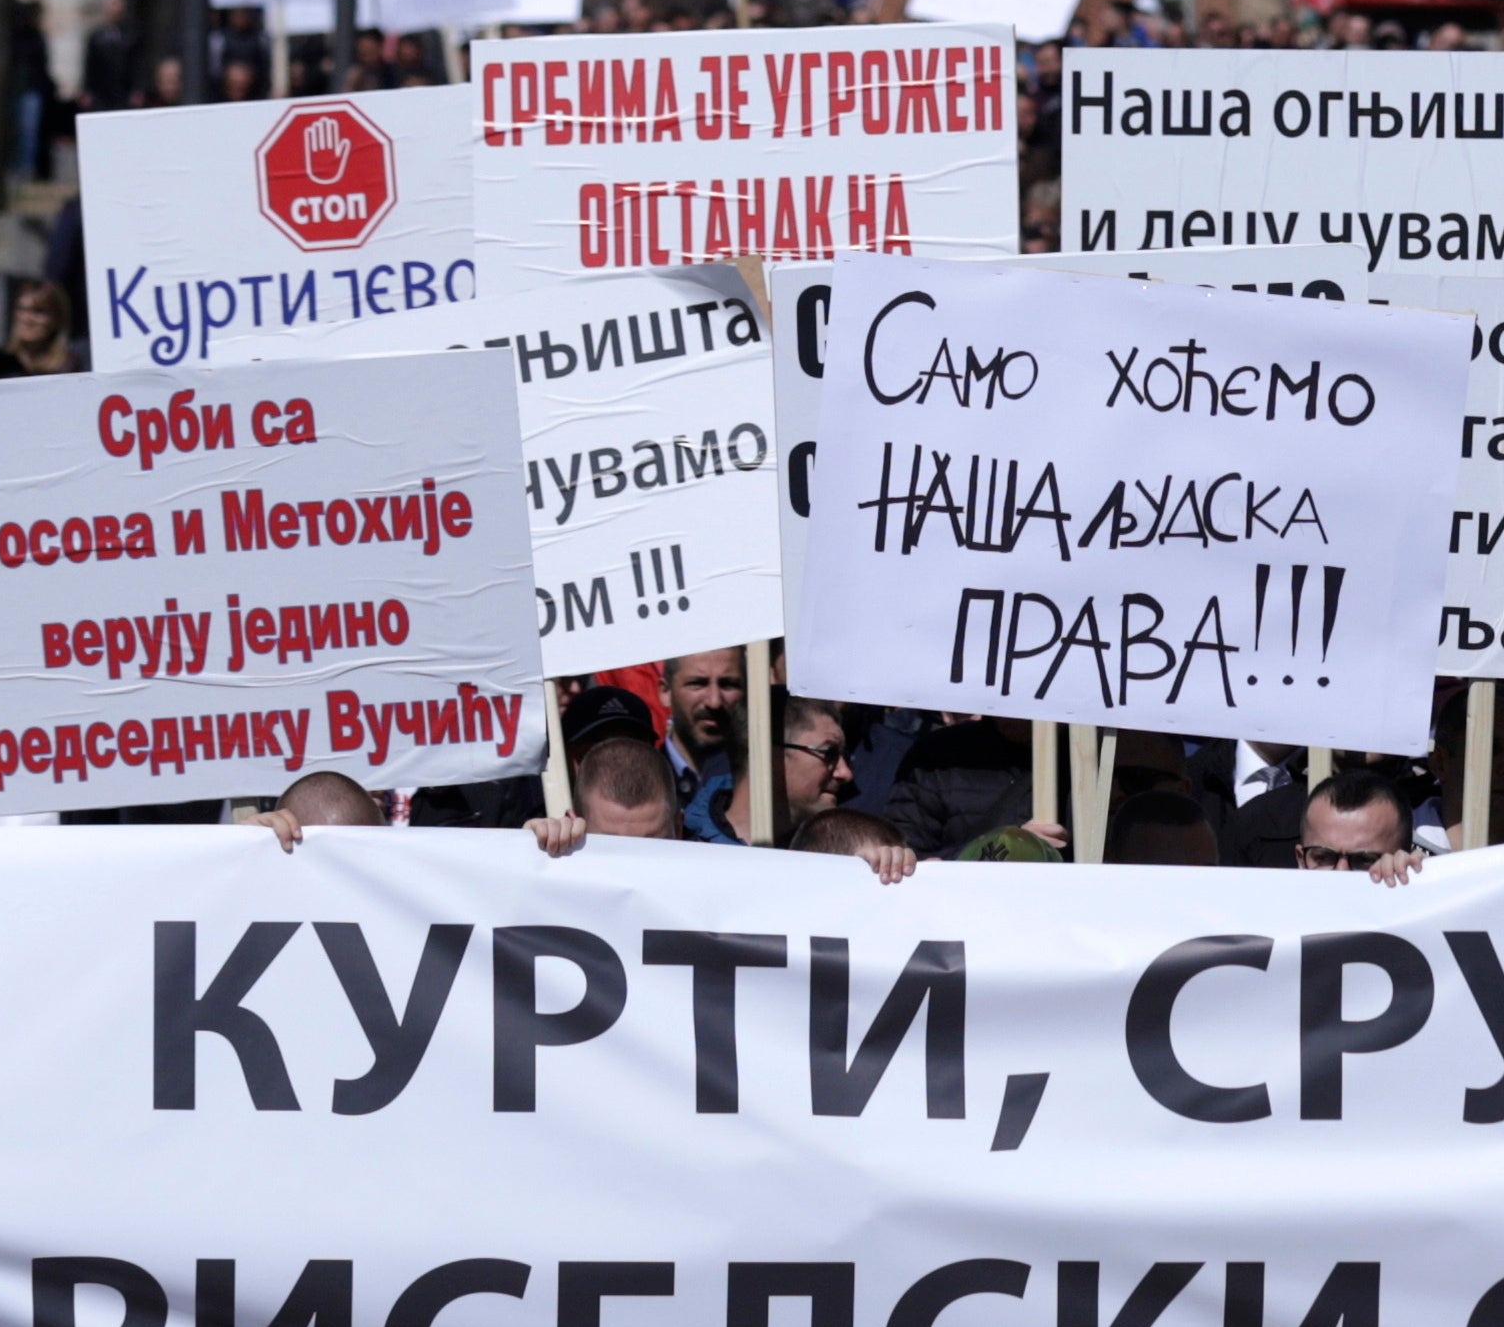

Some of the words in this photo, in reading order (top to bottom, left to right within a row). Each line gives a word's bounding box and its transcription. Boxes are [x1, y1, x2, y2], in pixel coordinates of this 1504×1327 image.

[485, 59, 681, 146] СРБИМА
[697, 56, 750, 140] ЈЕ
[766, 47, 1002, 137] УГРОЖЕН
[1072, 71, 1250, 137] Наша
[581, 177, 833, 267] ОПСТАНАК
[850, 175, 911, 255] НА
[100, 391, 233, 469] Срби
[254, 400, 314, 445] са
[173, 510, 206, 555] и
[224, 479, 471, 554] Метохије
[44, 600, 210, 678] верују
[229, 596, 408, 670] једино
[329, 685, 520, 764] Вучићу
[154, 922, 1049, 1150] КУРТИ,
